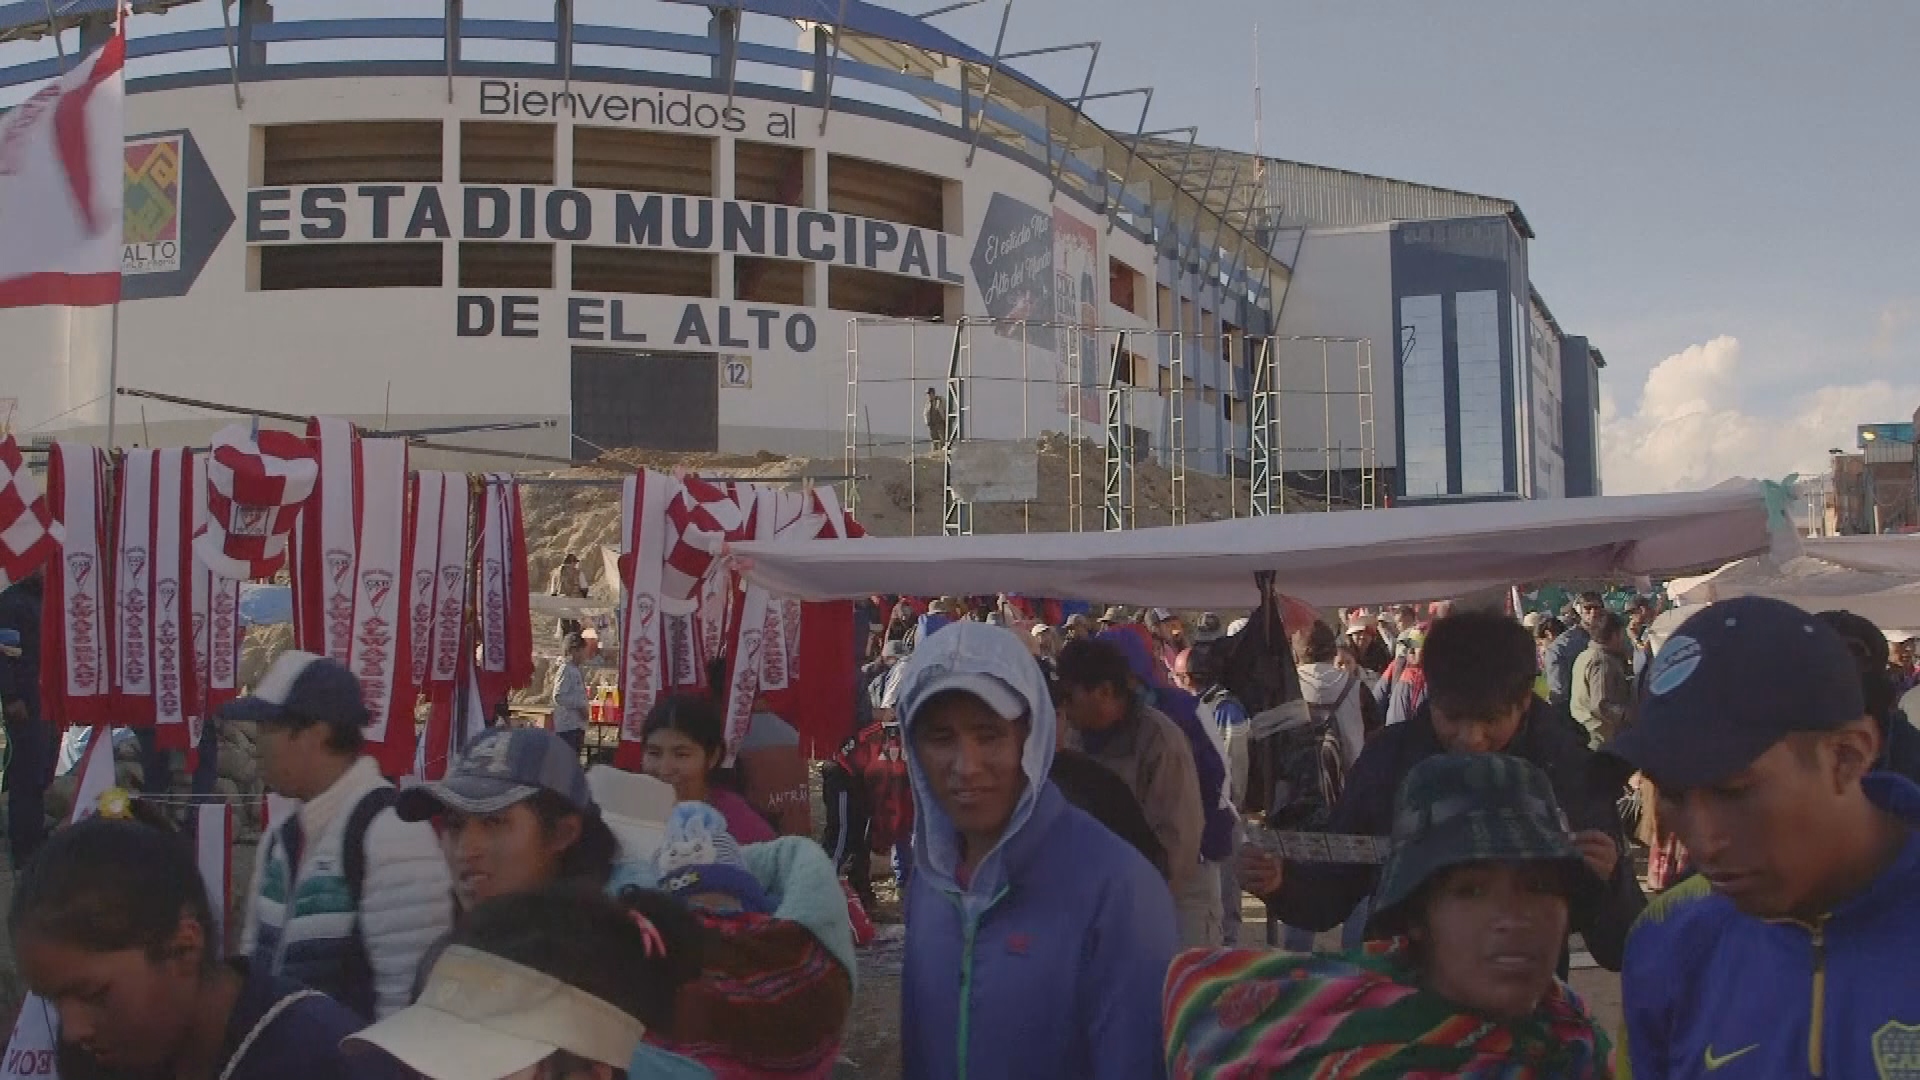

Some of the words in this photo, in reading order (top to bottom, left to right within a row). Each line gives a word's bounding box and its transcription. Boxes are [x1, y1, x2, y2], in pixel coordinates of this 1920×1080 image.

[480, 80, 746, 133] Bienvenidos
[767, 108, 797, 140] al
[122, 241, 177, 263] ALTO
[246, 184, 593, 242] ESTADIO
[615, 192, 965, 284] MUNICIPAL
[985, 234, 999, 265] El
[1000, 224, 1031, 257] estadio
[985, 271, 1010, 305] Alto
[1010, 261, 1025, 288] del
[1024, 247, 1052, 281] Mundo
[457, 294, 540, 338] DE
[568, 297, 647, 343] EL
[675, 303, 817, 353] ALTO
[727, 363, 745, 384] 12
